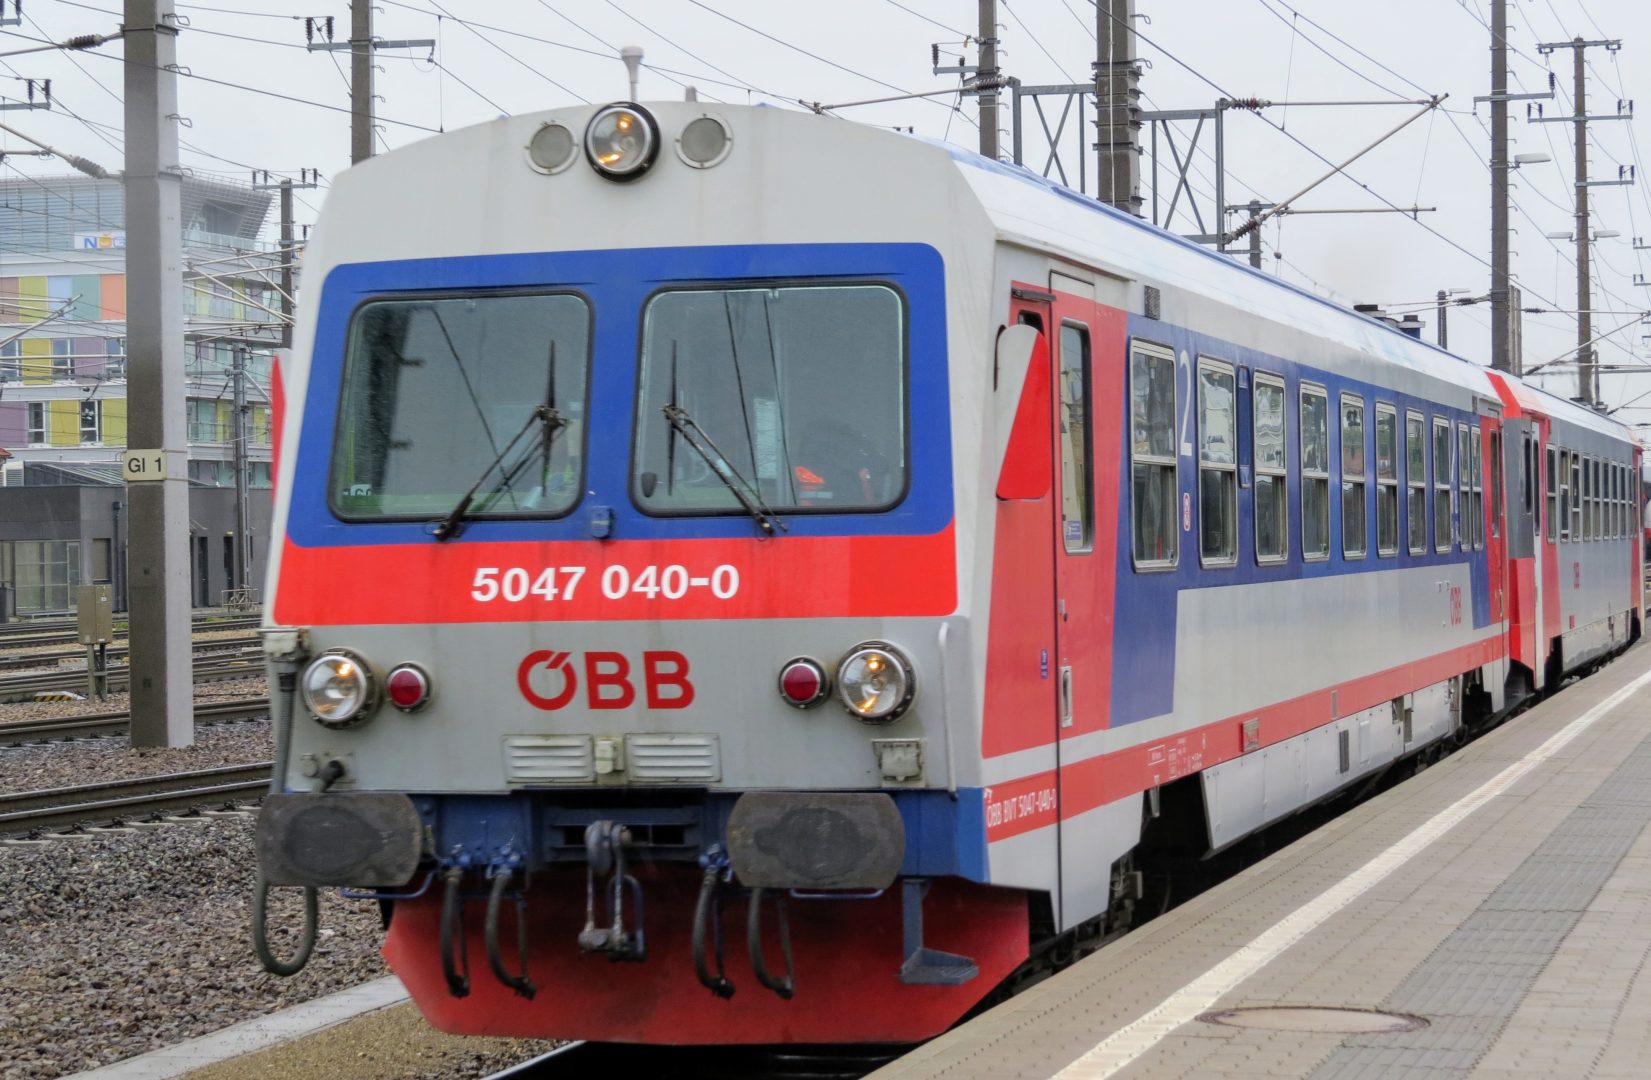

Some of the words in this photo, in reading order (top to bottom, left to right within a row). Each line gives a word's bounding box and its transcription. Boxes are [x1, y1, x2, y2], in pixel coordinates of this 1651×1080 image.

[1180, 350, 1192, 456] 2
[154, 456, 162, 473] 1
[471, 566, 586, 602] 5047
[601, 564, 739, 600] 040-0
[517, 649, 695, 711] ÖBB
